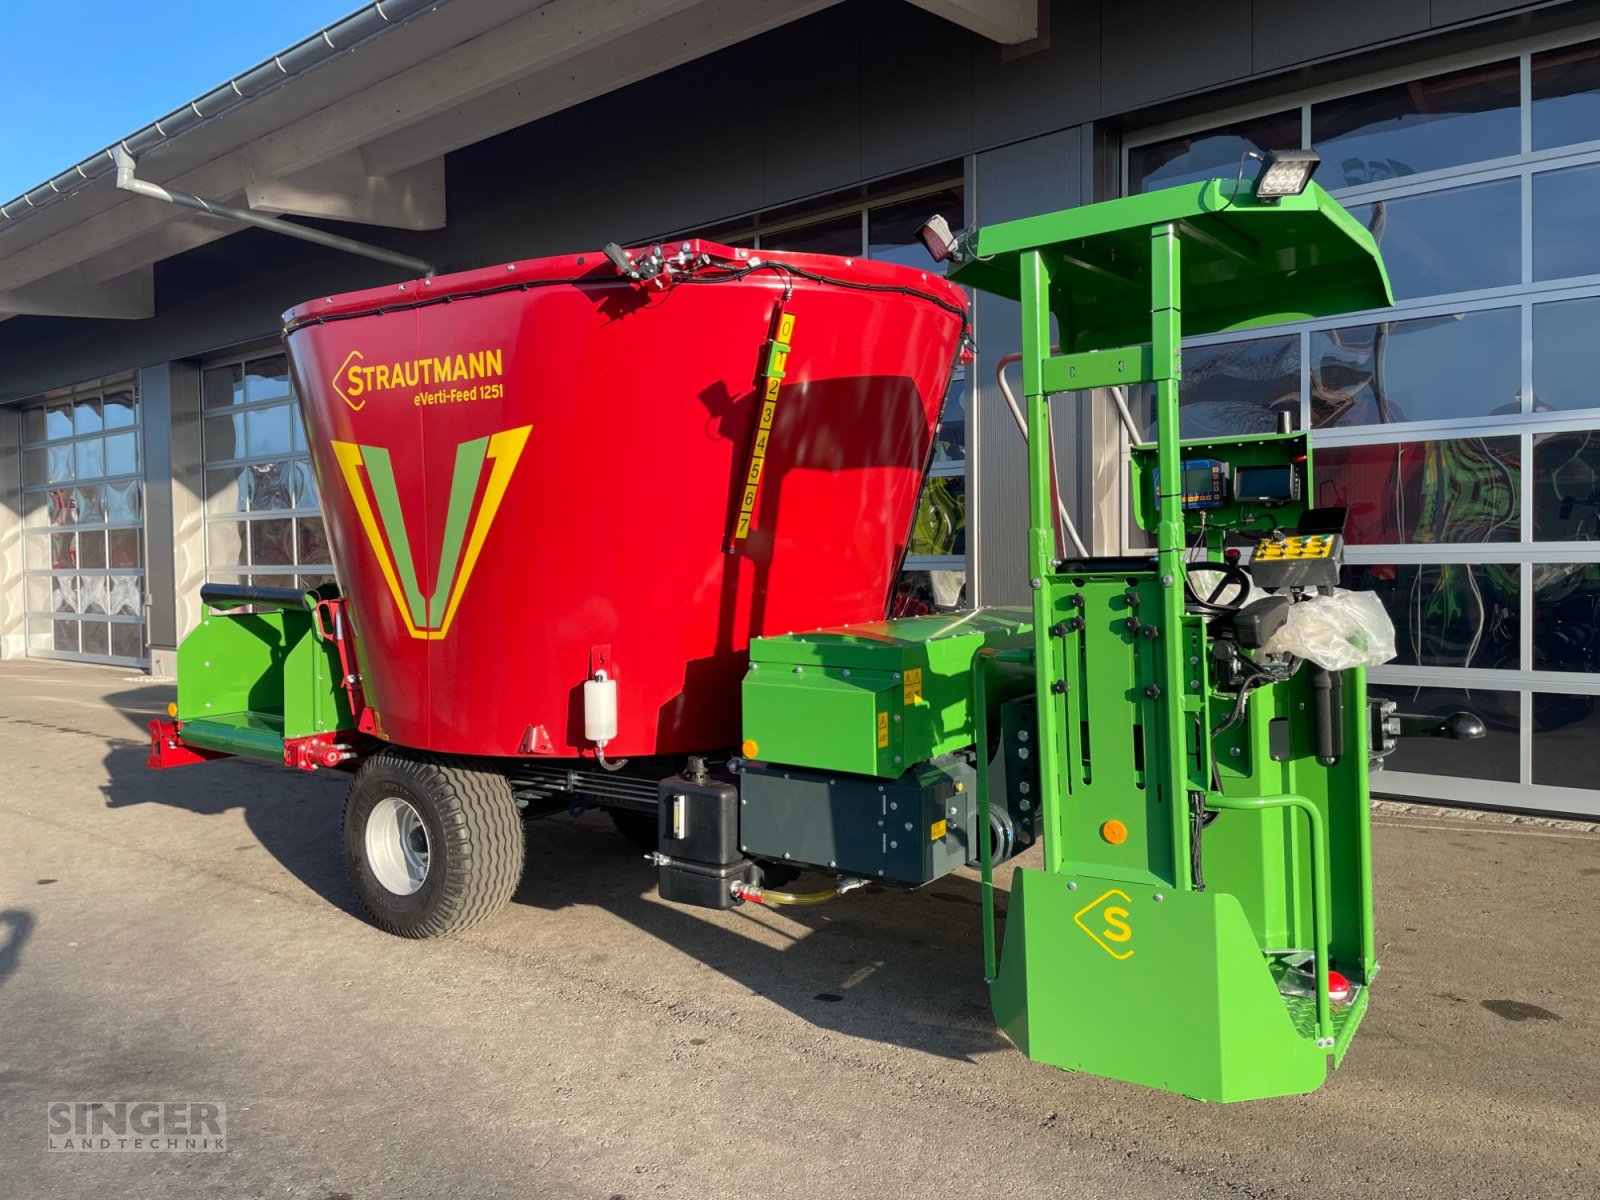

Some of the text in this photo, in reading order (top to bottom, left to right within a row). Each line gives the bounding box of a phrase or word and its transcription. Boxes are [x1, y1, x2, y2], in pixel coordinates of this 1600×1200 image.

[782, 321, 791, 336] 0
[348, 349, 502, 396] STRAUTMANN
[414, 384, 503, 406] eVerti-Feed 1251
[769, 380, 779, 395] 2
[763, 408, 772, 423] 3
[757, 436, 766, 451] 4
[750, 464, 760, 478] 5
[745, 491, 754, 506] 6
[740, 518, 748, 532] 7
[1103, 906, 1132, 942] S
